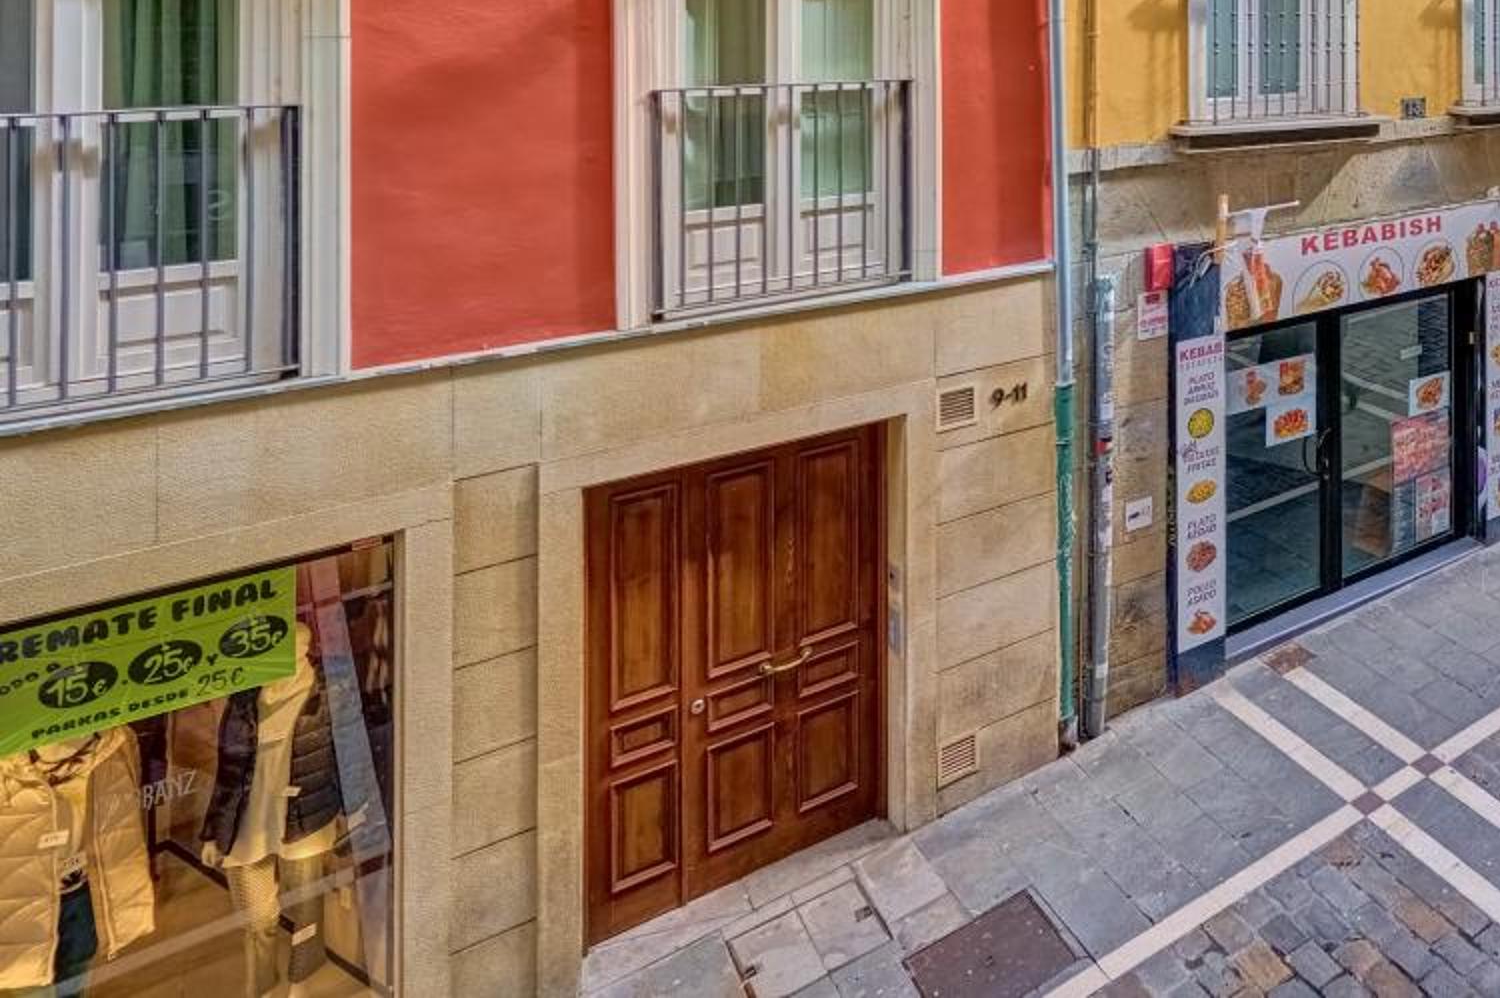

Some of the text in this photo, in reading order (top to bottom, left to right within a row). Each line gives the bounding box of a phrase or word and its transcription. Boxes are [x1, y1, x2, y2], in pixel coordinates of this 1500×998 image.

[1301, 215, 1442, 256] KEBABISH
[989, 382, 1028, 411] 9-11
[0, 579, 277, 665] REMATE FINAL
[31, 666, 244, 739] PARKAS DESDE 25€
